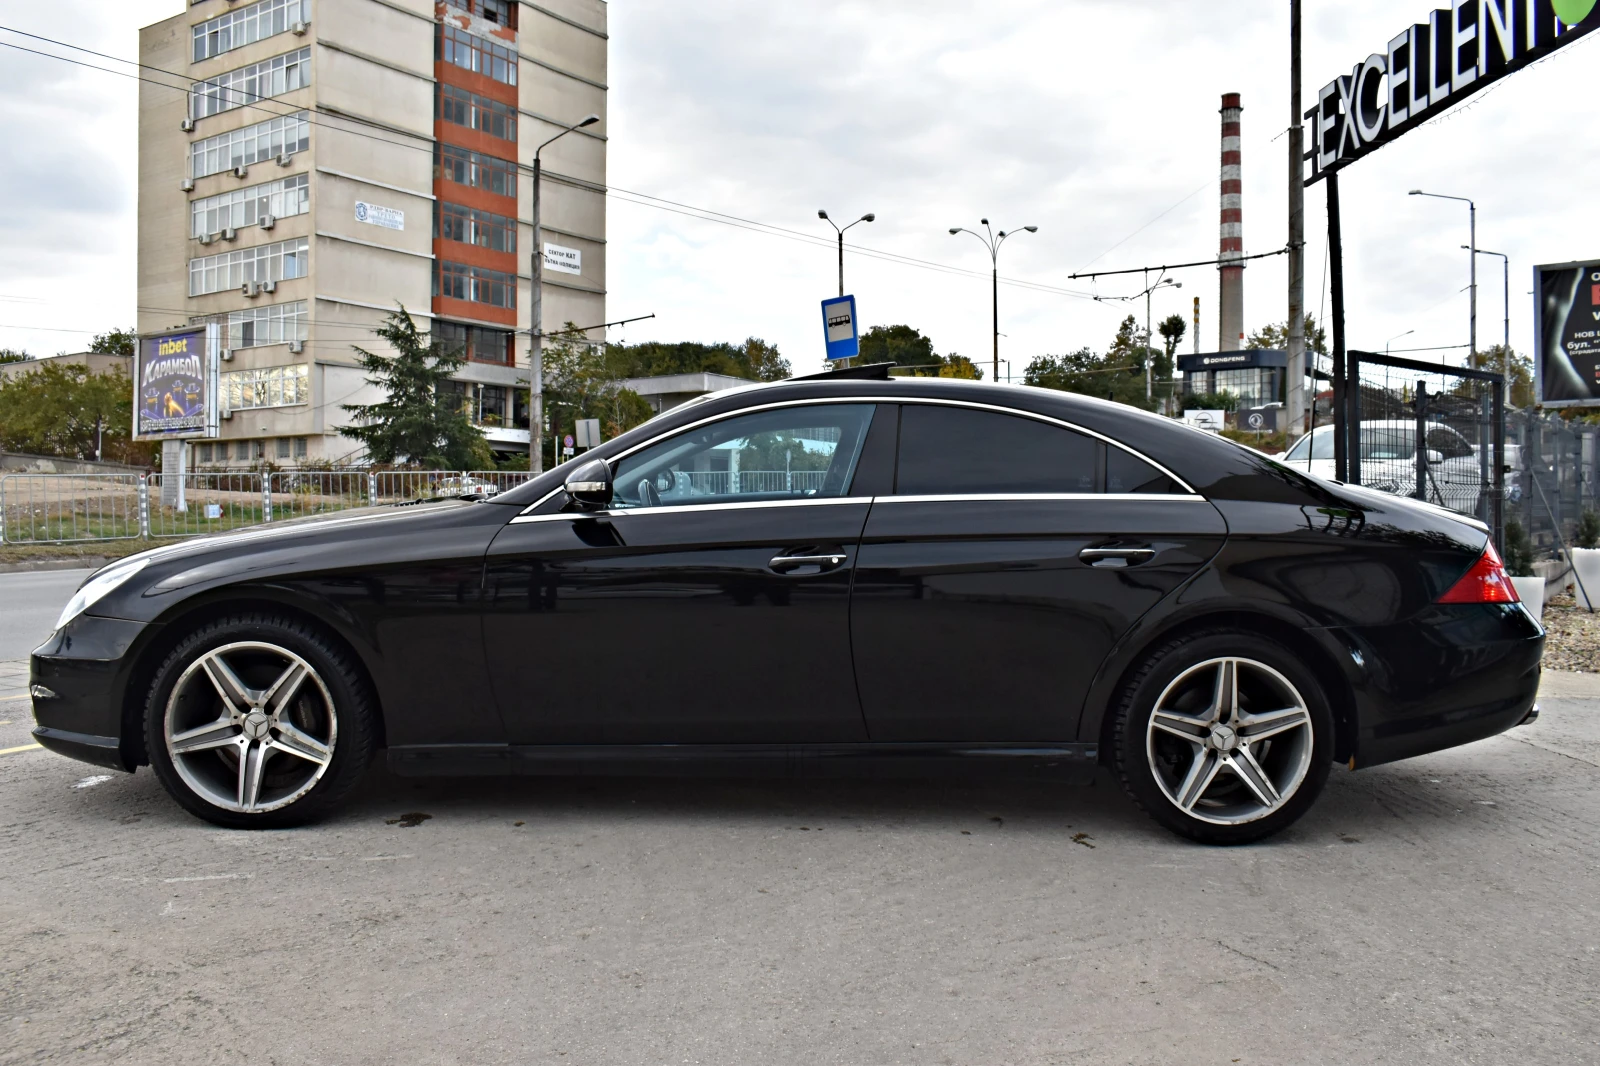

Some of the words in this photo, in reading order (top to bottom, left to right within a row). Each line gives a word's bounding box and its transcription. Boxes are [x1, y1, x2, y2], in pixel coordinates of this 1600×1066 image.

[549, 249, 565, 257] СЕКТОР
[565, 252, 576, 260] КАТ
[1574, 330, 1595, 339] НОВ
[158, 338, 187, 355] inbet
[1566, 341, 1591, 351] бул.
[142, 354, 203, 388] КАРАМБОЛ
